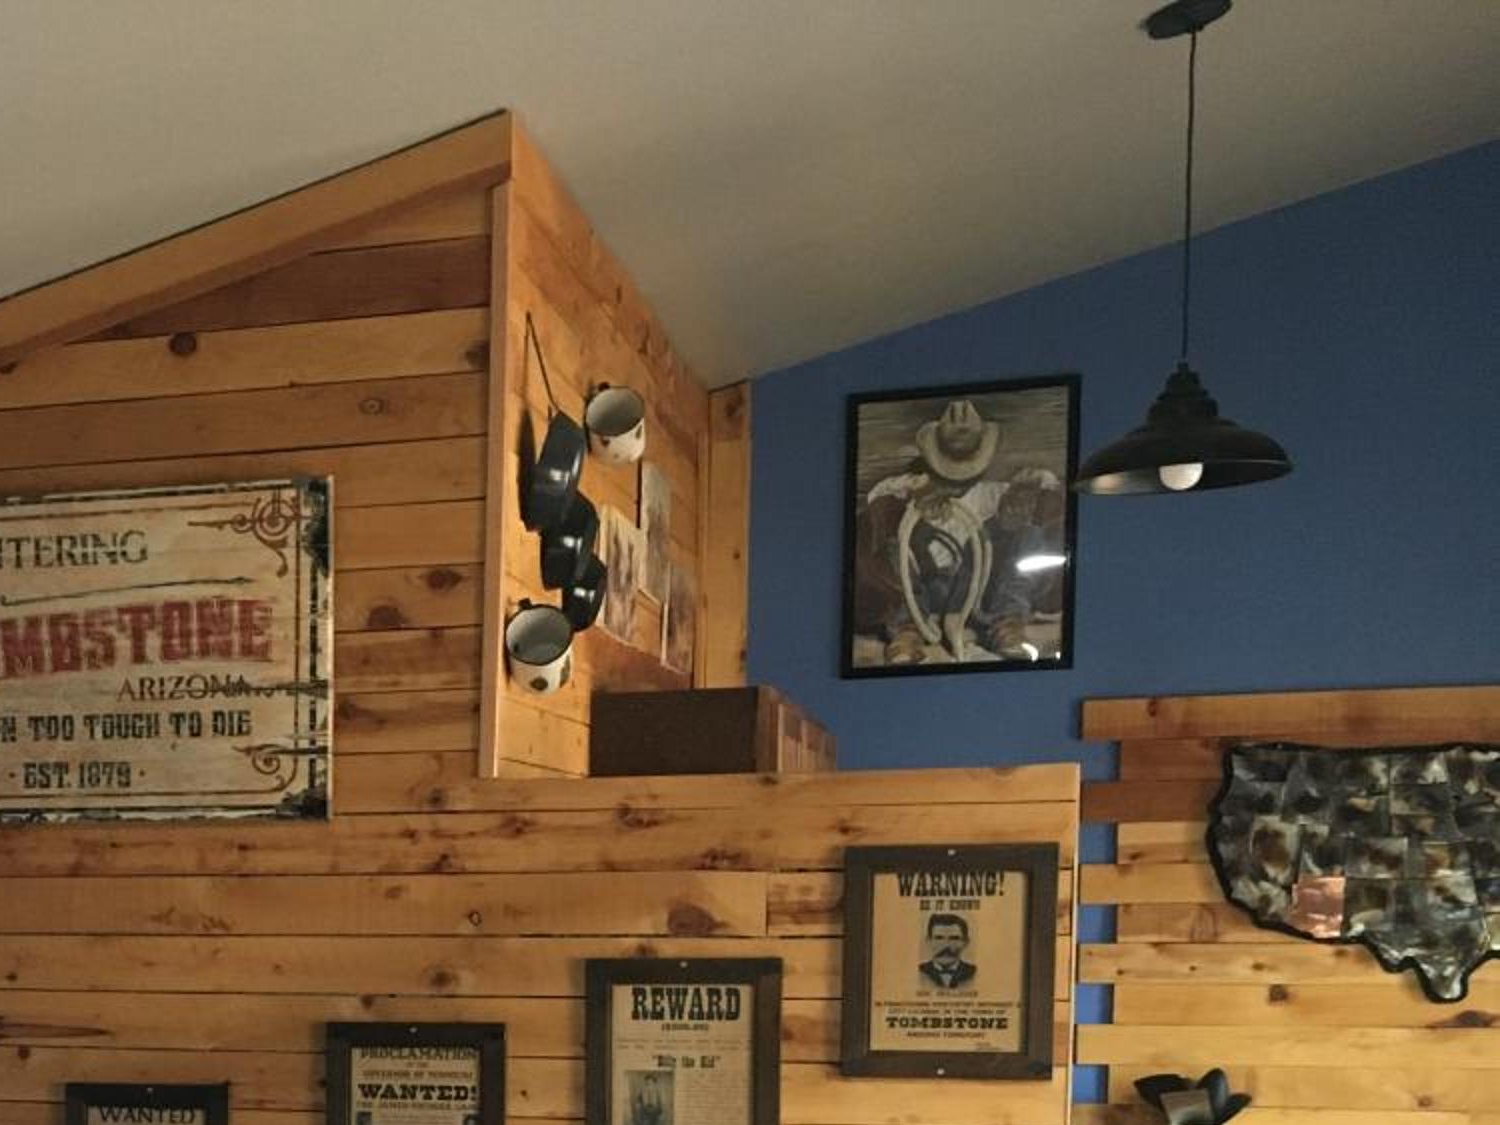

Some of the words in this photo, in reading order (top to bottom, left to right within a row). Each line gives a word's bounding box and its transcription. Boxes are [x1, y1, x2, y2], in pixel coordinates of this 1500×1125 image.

[117, 673, 253, 701] ARIZONA
[27, 714, 75, 742] TOO
[83, 713, 160, 740] TOUGH
[168, 711, 201, 739] TO
[211, 709, 252, 737] DIE
[22, 761, 71, 788] EST.
[78, 760, 132, 787] 1879
[898, 869, 1005, 897] WARNING!
[631, 987, 741, 1021] REWARD
[885, 1017, 1009, 1030] TOMBSTONE
[357, 1083, 477, 1101] WANTED!
[100, 1105, 196, 1125] WANTED
